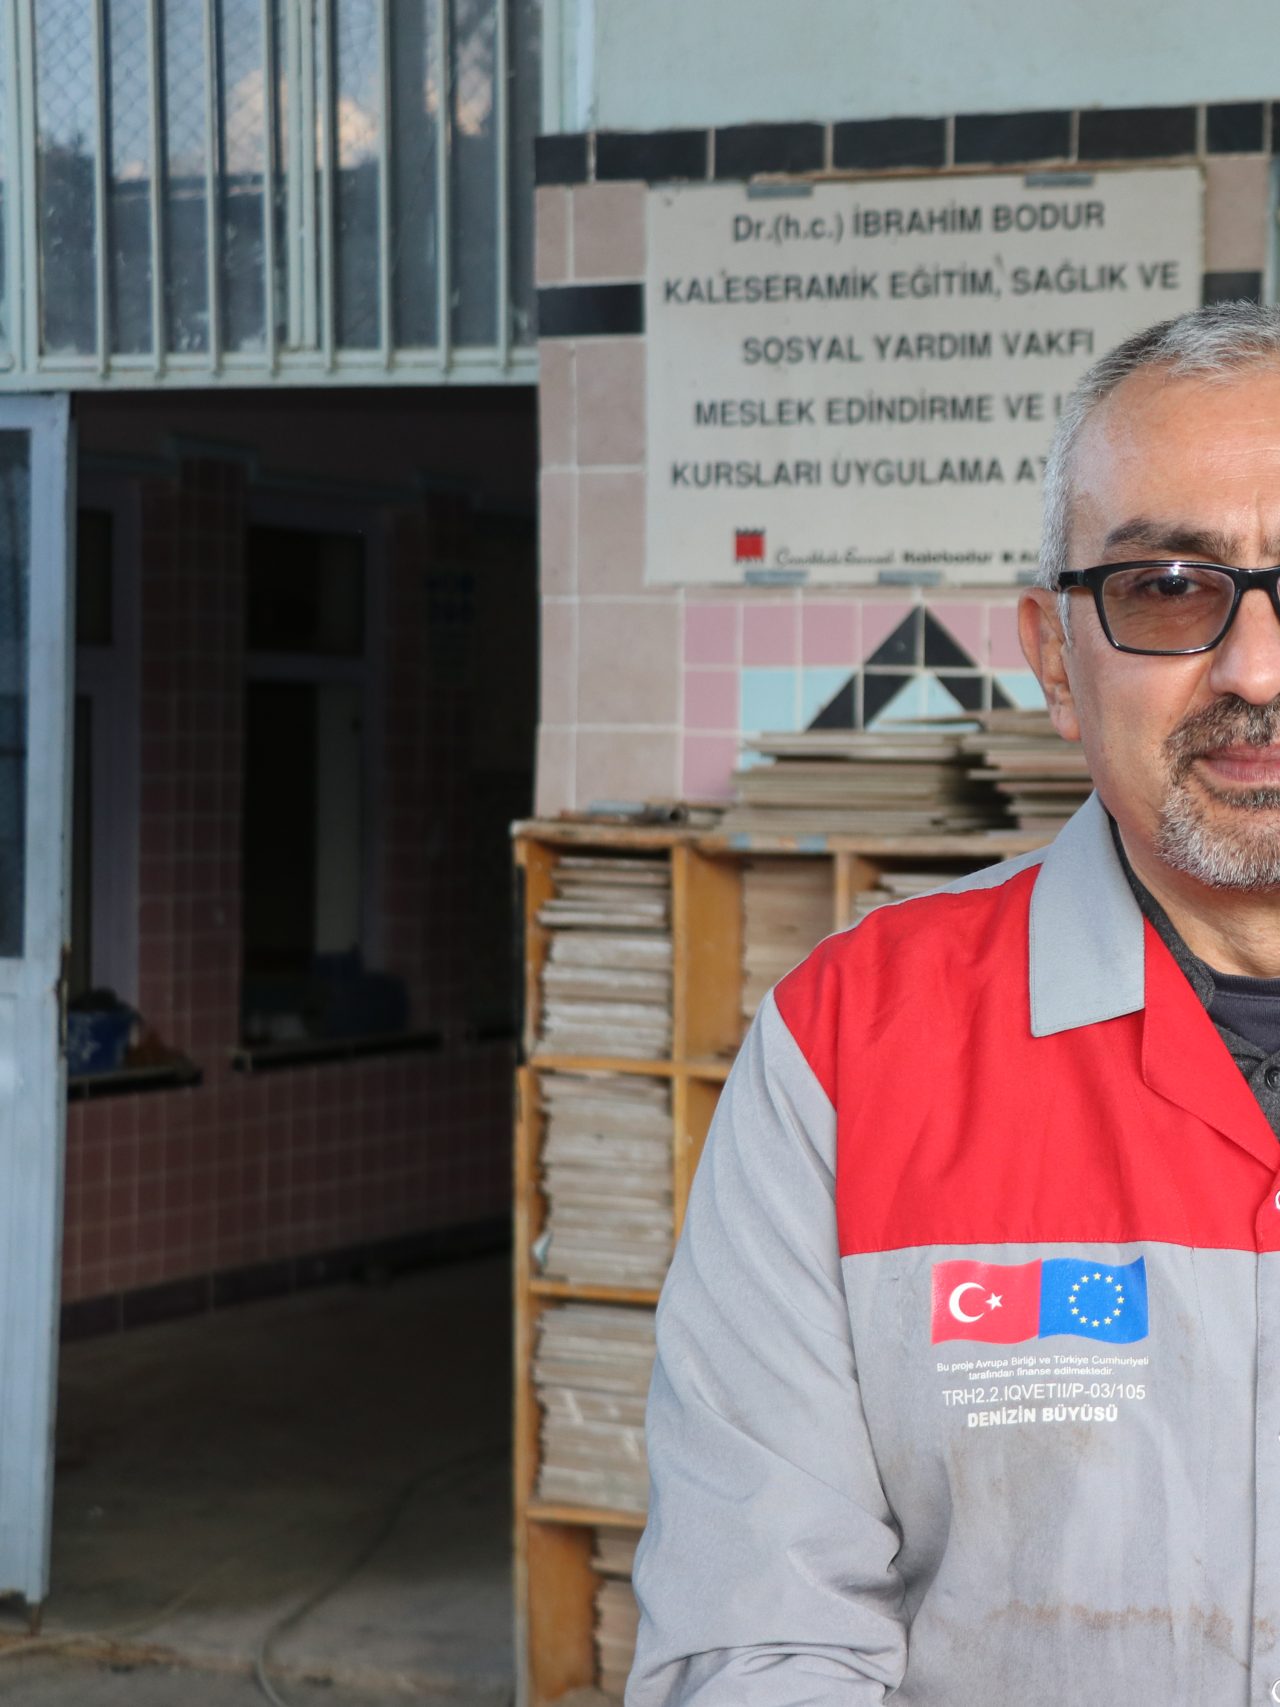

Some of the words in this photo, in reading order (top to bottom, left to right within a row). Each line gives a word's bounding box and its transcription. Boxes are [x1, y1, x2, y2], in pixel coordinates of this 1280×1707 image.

[733, 212, 845, 245] Dr.(h.c.)
[854, 202, 982, 238] İBRAHİM
[992, 201, 1106, 233] BODUR
[663, 266, 878, 303] KALESERAMİK
[890, 262, 1003, 300] EĞİTİM,
[1011, 258, 1128, 295] SAĞLIK
[1138, 261, 1180, 291] VE
[742, 335, 863, 365] SOSYAL
[873, 333, 992, 361] YARDIM
[1001, 329, 1095, 357] VAKFI
[695, 399, 815, 427] MESLEK
[826, 390, 993, 425] EDİNDİRME
[1003, 394, 1043, 421] VE
[671, 459, 820, 488] KURSLARI
[937, 1362, 950, 1373] Bu
[951, 1360, 974, 1374] proje
[976, 1358, 1009, 1372] Avrupa
[1011, 1355, 1037, 1368] Birliği
[1039, 1356, 1051, 1365] ve
[1053, 1354, 1089, 1367] Türkiye
[1091, 1355, 1150, 1368] Cumhuriyeti
[968, 1369, 1015, 1381] tarafından
[1017, 1367, 1052, 1377] finanse
[1053, 1365, 1115, 1377] edilmektedir.
[967, 1404, 1037, 1428] DENİZİN
[1042, 1403, 1119, 1424] BÜYÜSÜ
